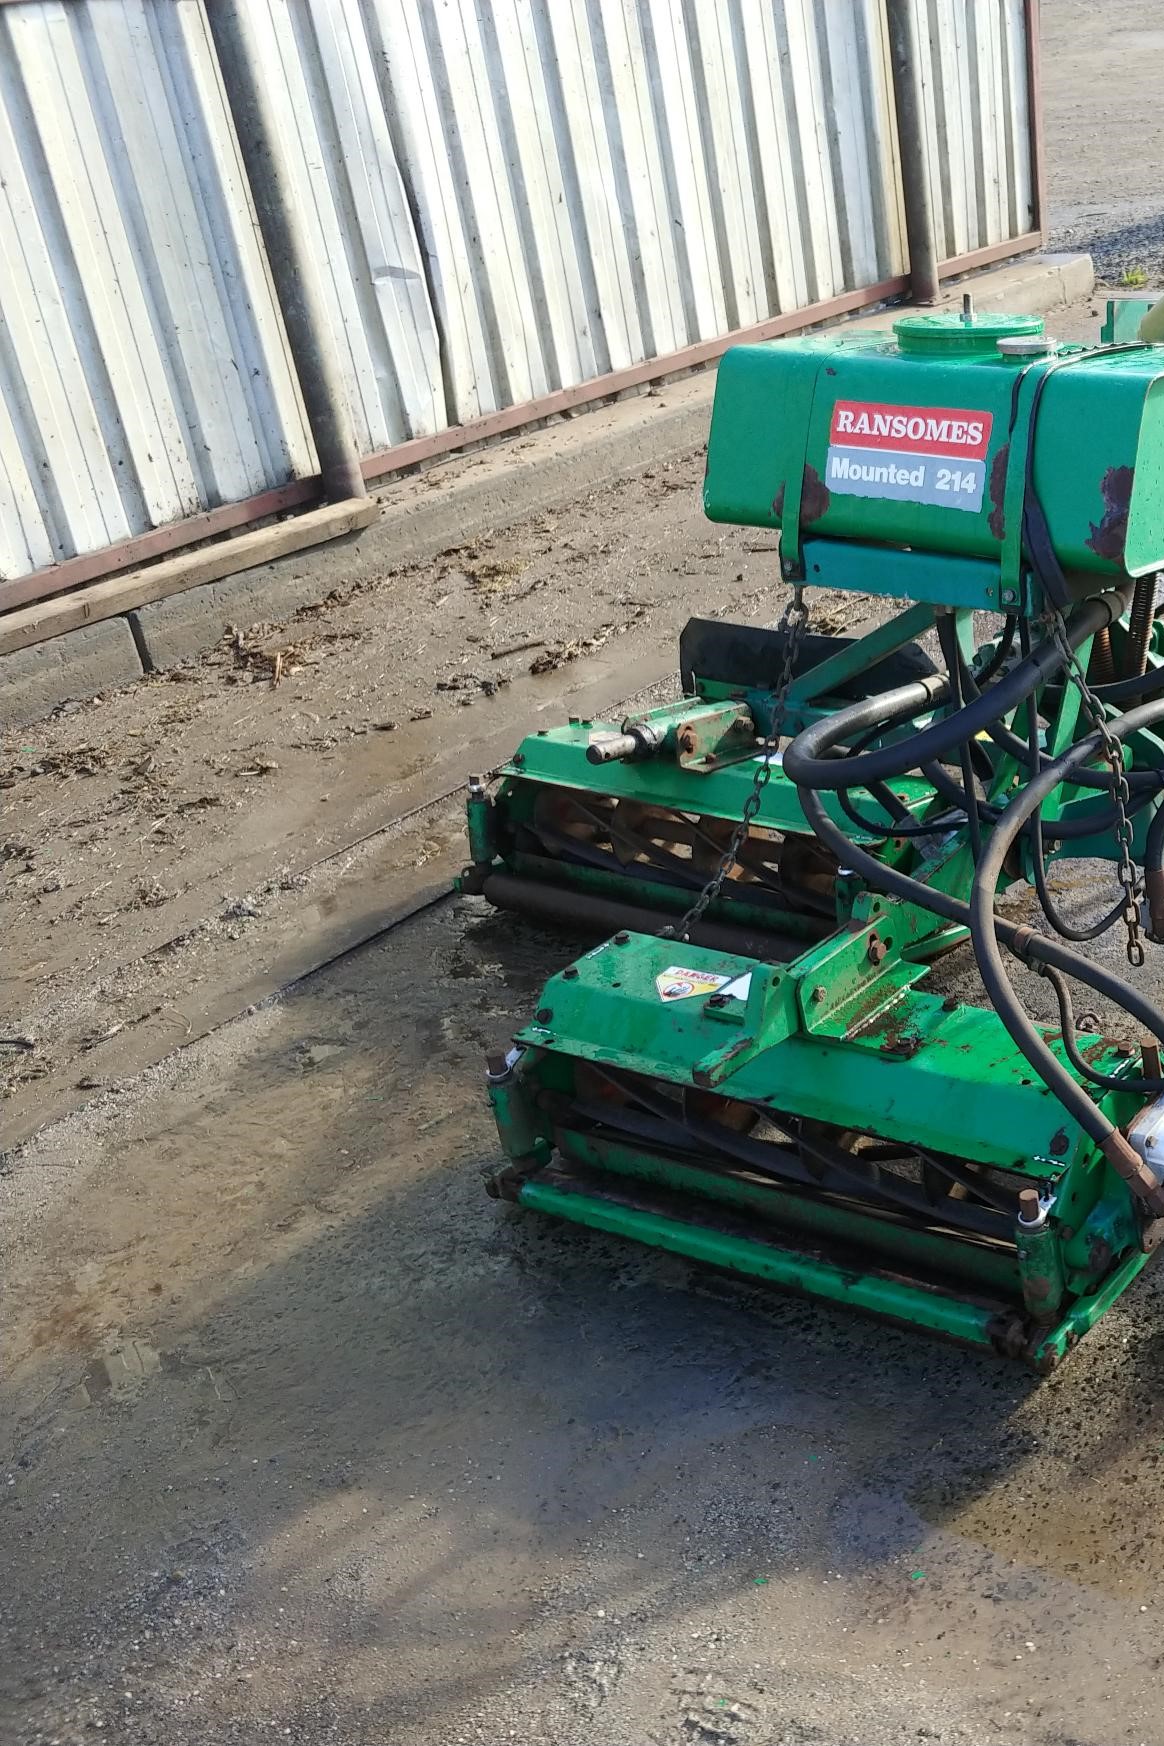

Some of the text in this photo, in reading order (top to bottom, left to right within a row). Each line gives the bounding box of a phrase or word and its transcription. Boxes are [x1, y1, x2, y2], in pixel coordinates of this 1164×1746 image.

[836, 410, 984, 445] RANSOMES
[831, 457, 977, 494] Mounted 214
[675, 969, 719, 982] DANGER
